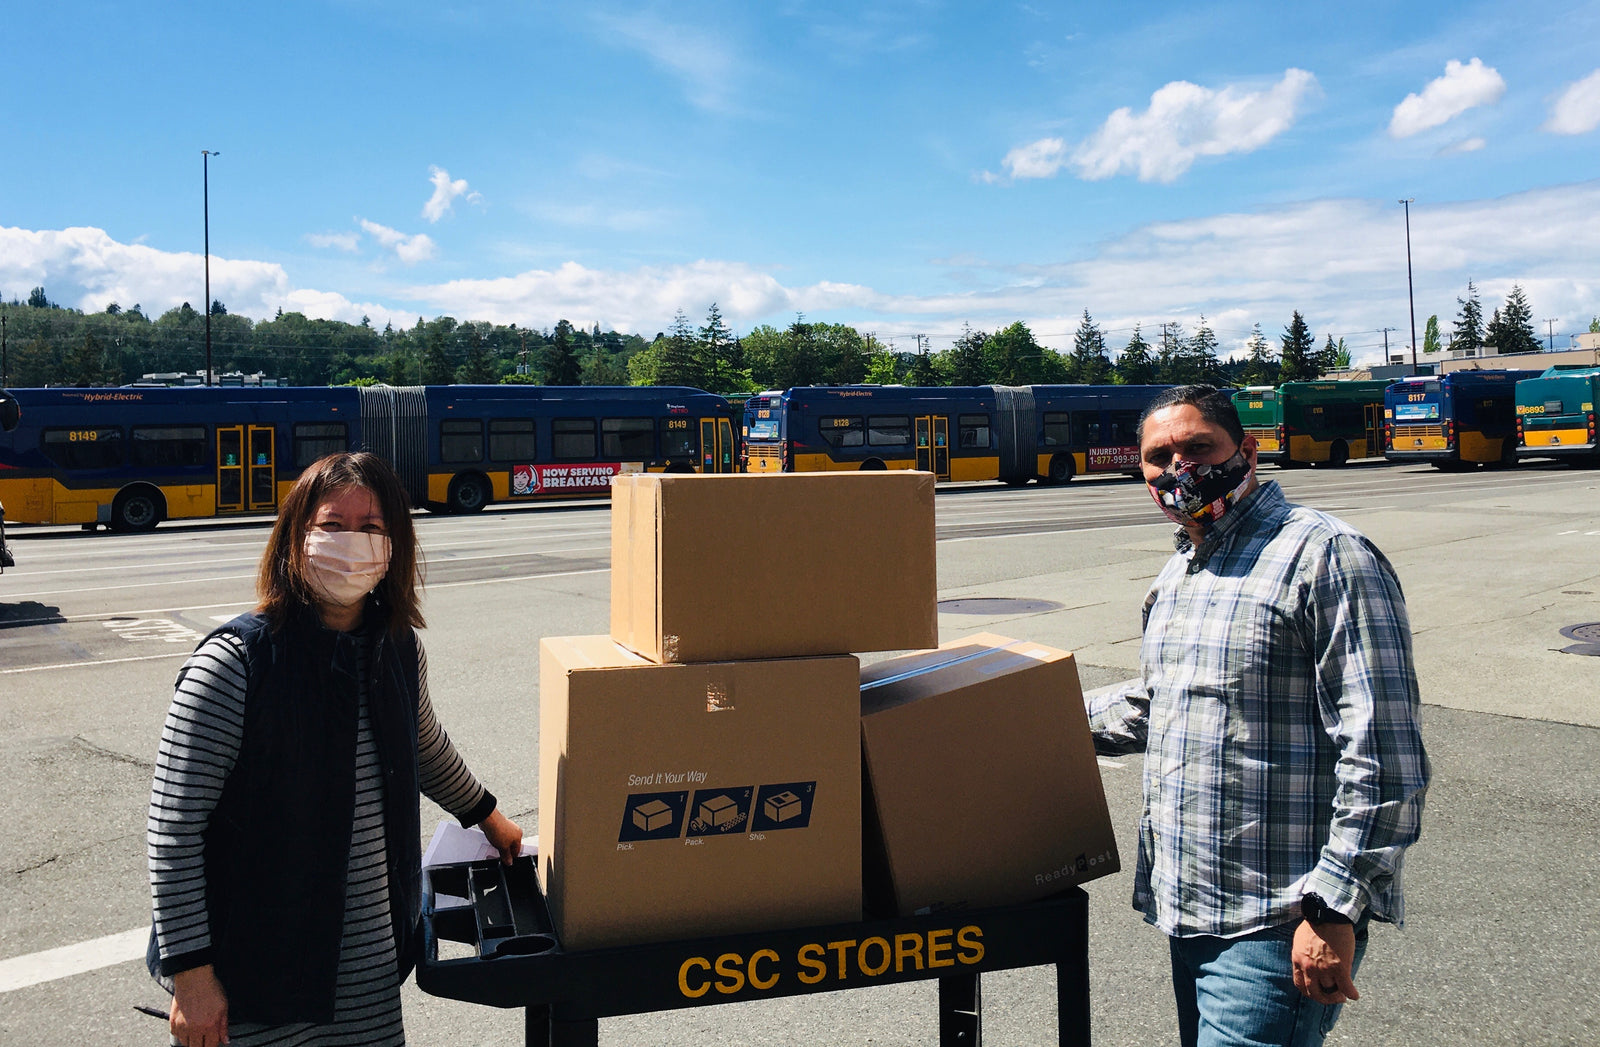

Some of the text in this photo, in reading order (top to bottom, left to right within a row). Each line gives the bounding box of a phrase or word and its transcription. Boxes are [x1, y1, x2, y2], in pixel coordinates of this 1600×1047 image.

[84, 392, 143, 402] Hybrid-Electric
[1408, 393, 1426, 402] 8117
[1525, 405, 1545, 414] 6893
[668, 420, 687, 429] 8149
[833, 418, 850, 427] 8128
[69, 431, 97, 441] 8149
[1089, 447, 1121, 456] INJURED?
[542, 467, 614, 477] NOW SERVING
[542, 476, 615, 488] BREAKFAST
[627, 770, 708, 786] Send It Your Way
[743, 789, 750, 798] 2
[806, 785, 812, 793] 3
[680, 794, 685, 802] 1
[749, 833, 767, 841] Ship.
[684, 838, 705, 846] Pack.
[616, 843, 635, 851] Pick.
[678, 925, 985, 998] CSC STORES
